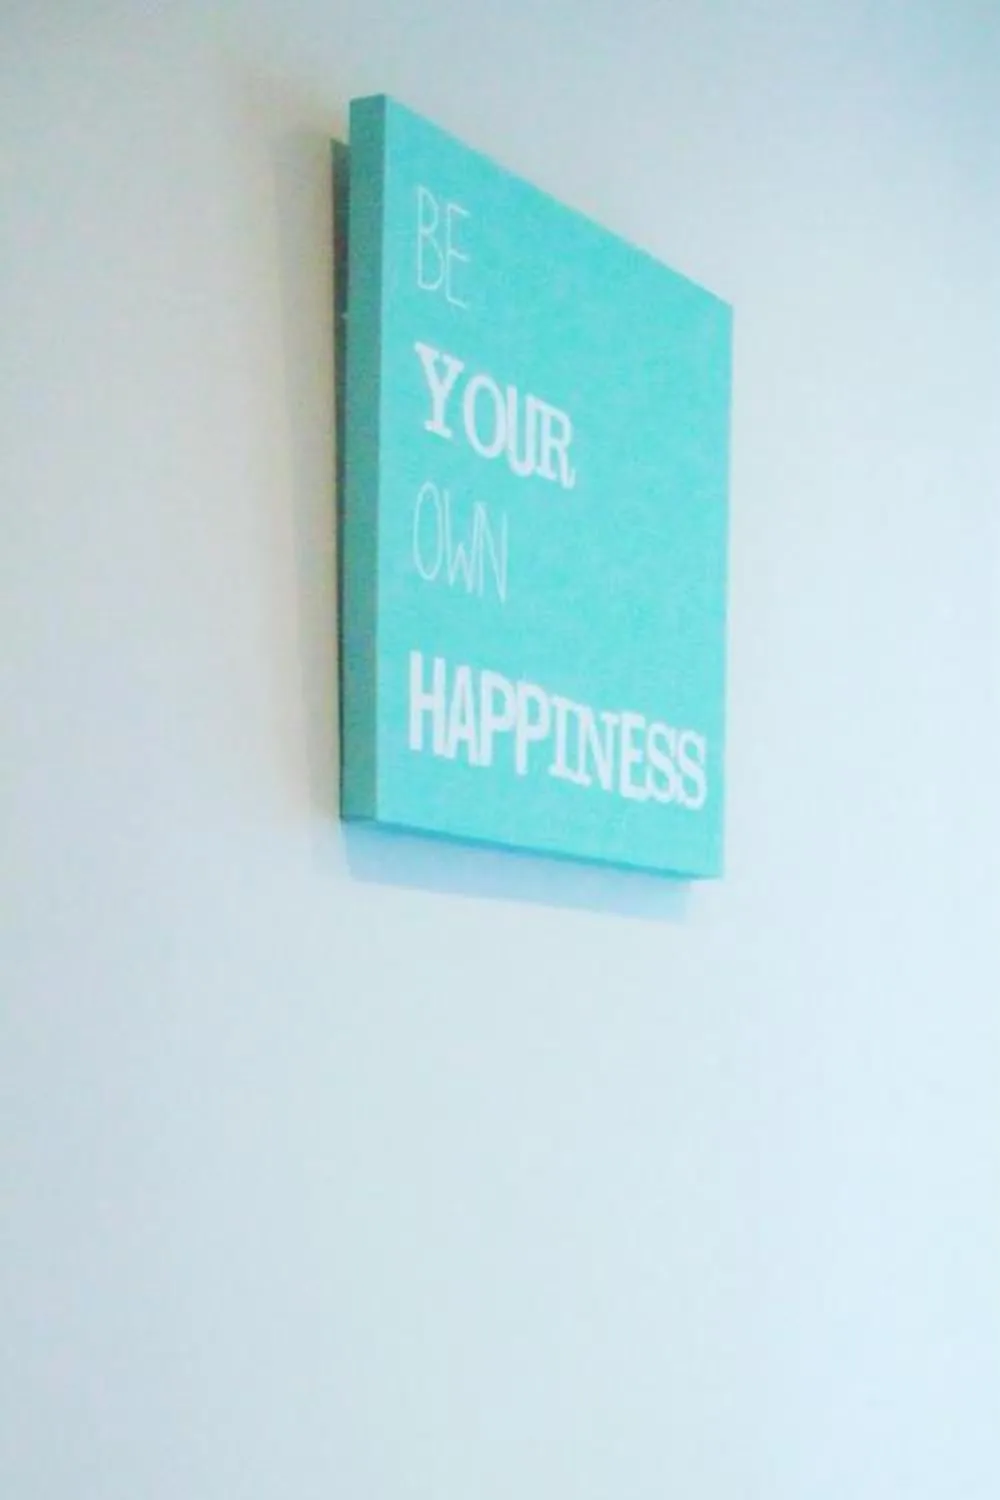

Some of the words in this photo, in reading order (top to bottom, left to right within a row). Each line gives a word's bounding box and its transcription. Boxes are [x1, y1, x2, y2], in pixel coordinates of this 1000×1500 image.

[416, 185, 471, 310] BE
[414, 342, 575, 489] YOUR
[413, 481, 508, 602] OWN
[409, 650, 707, 810] HAPPINESS
